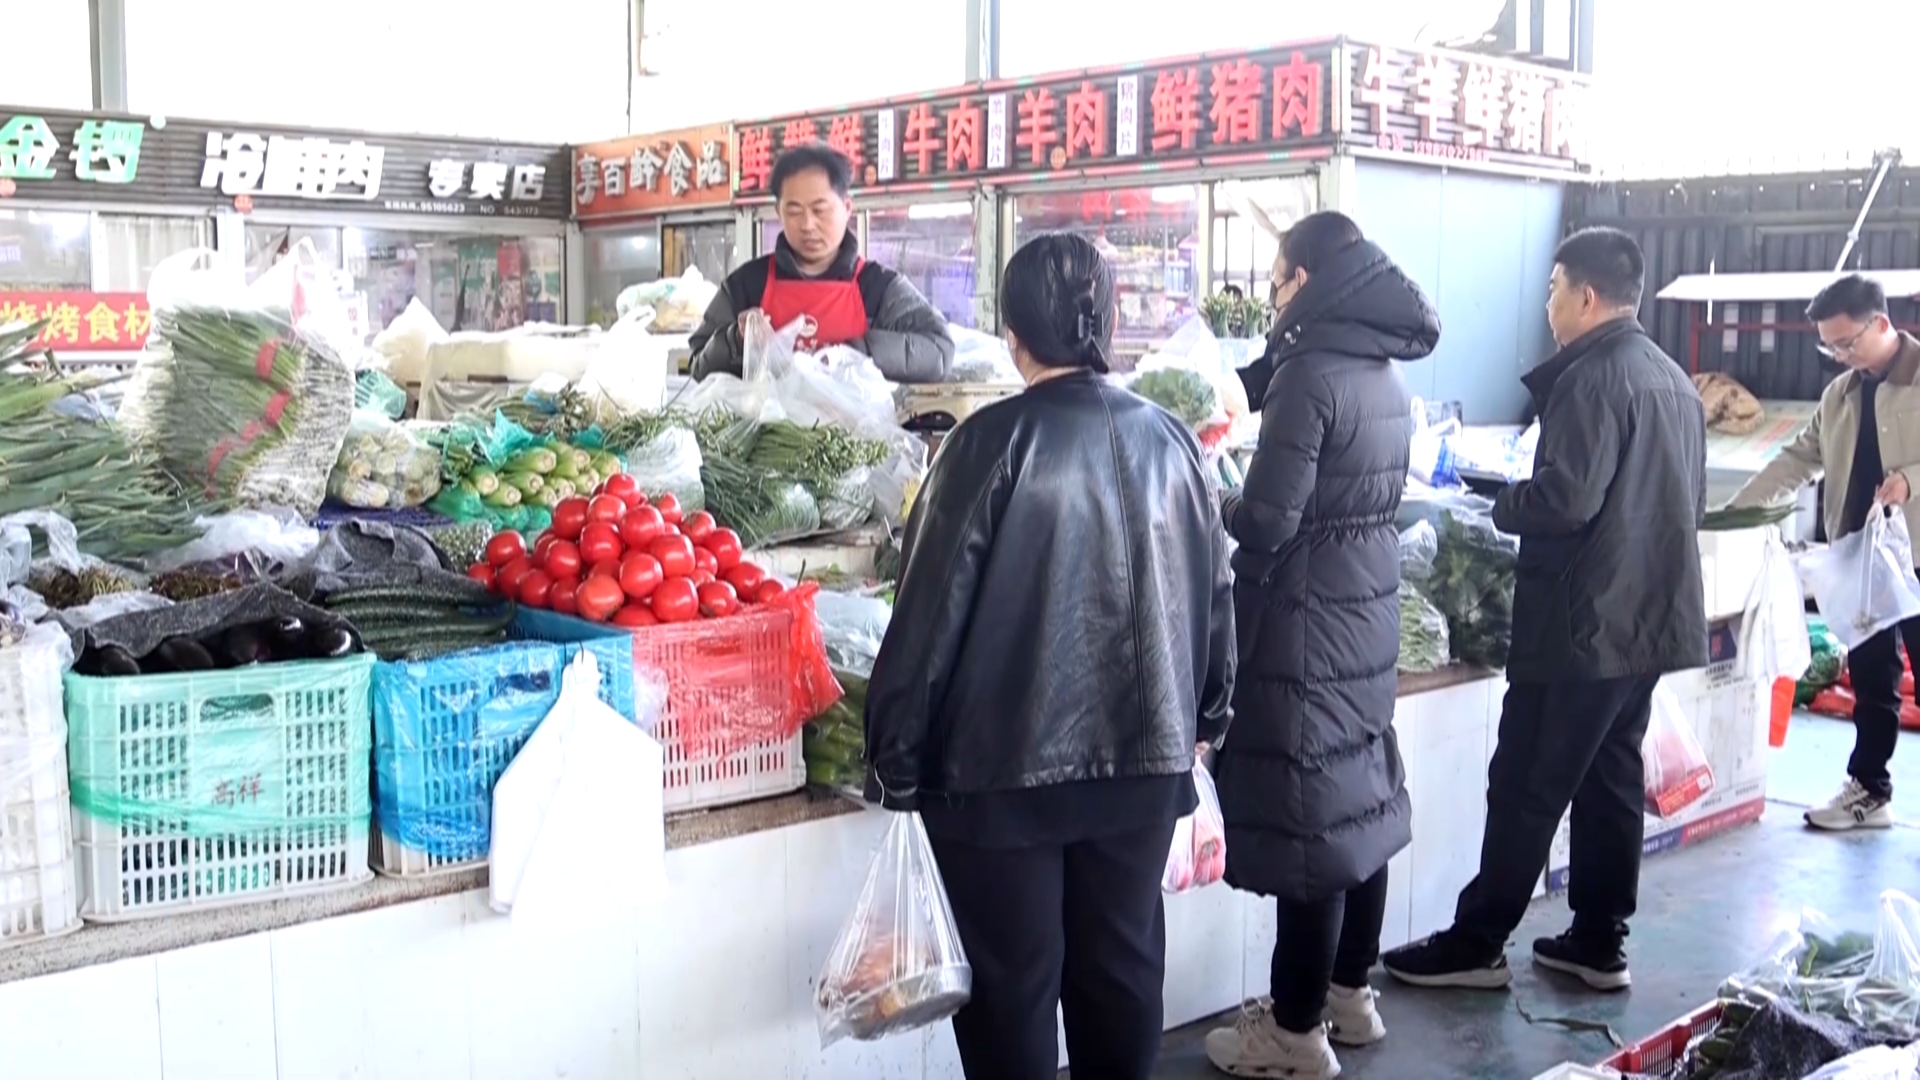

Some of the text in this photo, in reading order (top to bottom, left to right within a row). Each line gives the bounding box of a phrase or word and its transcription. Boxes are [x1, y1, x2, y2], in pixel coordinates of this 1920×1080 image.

[0, 115, 145, 183] 金锣
[903, 97, 982, 175] 牛肉
[1016, 81, 1106, 165] 羊肉
[1151, 51, 1322, 151] 鲜猪肉
